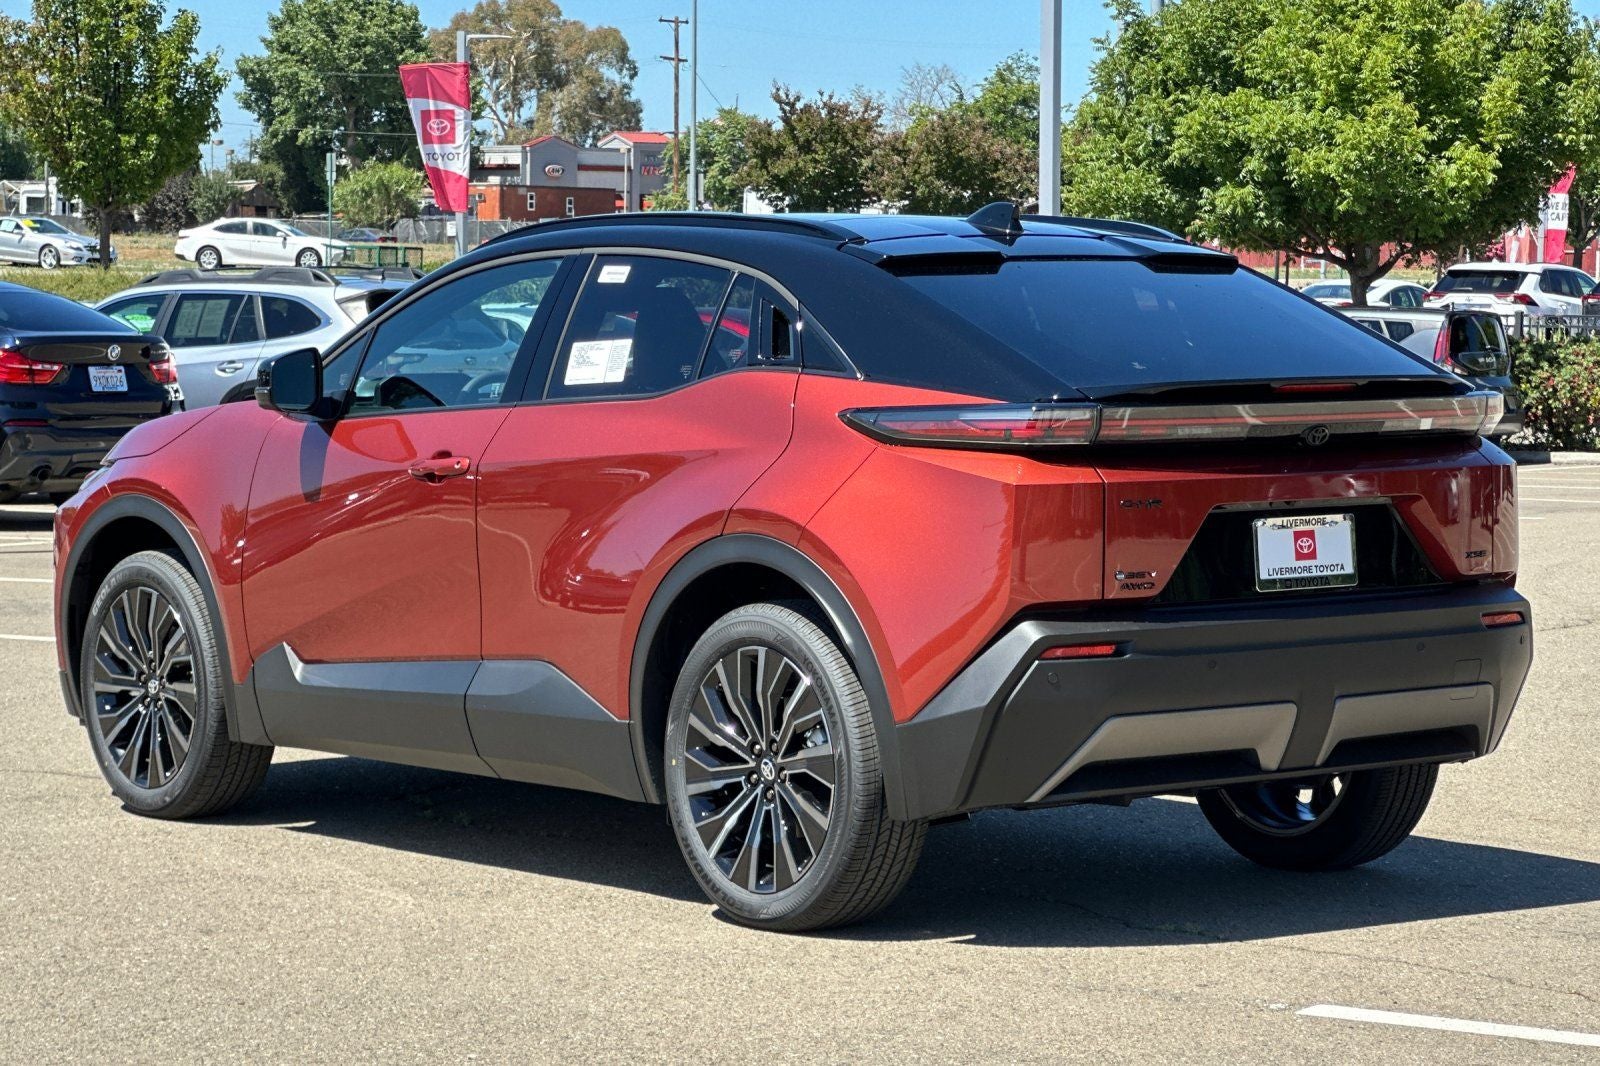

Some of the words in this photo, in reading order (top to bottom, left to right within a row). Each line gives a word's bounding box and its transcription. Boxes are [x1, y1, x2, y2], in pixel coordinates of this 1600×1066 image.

[1281, 516, 1327, 529] LIVERMORE
[1267, 565, 1313, 577] LIVERMORE
[1314, 563, 1345, 574] TOYOTA
[1119, 581, 1157, 591] AWD
[1294, 575, 1331, 588] TOYOTA
[800, 654, 839, 730] YOKOHAMA
